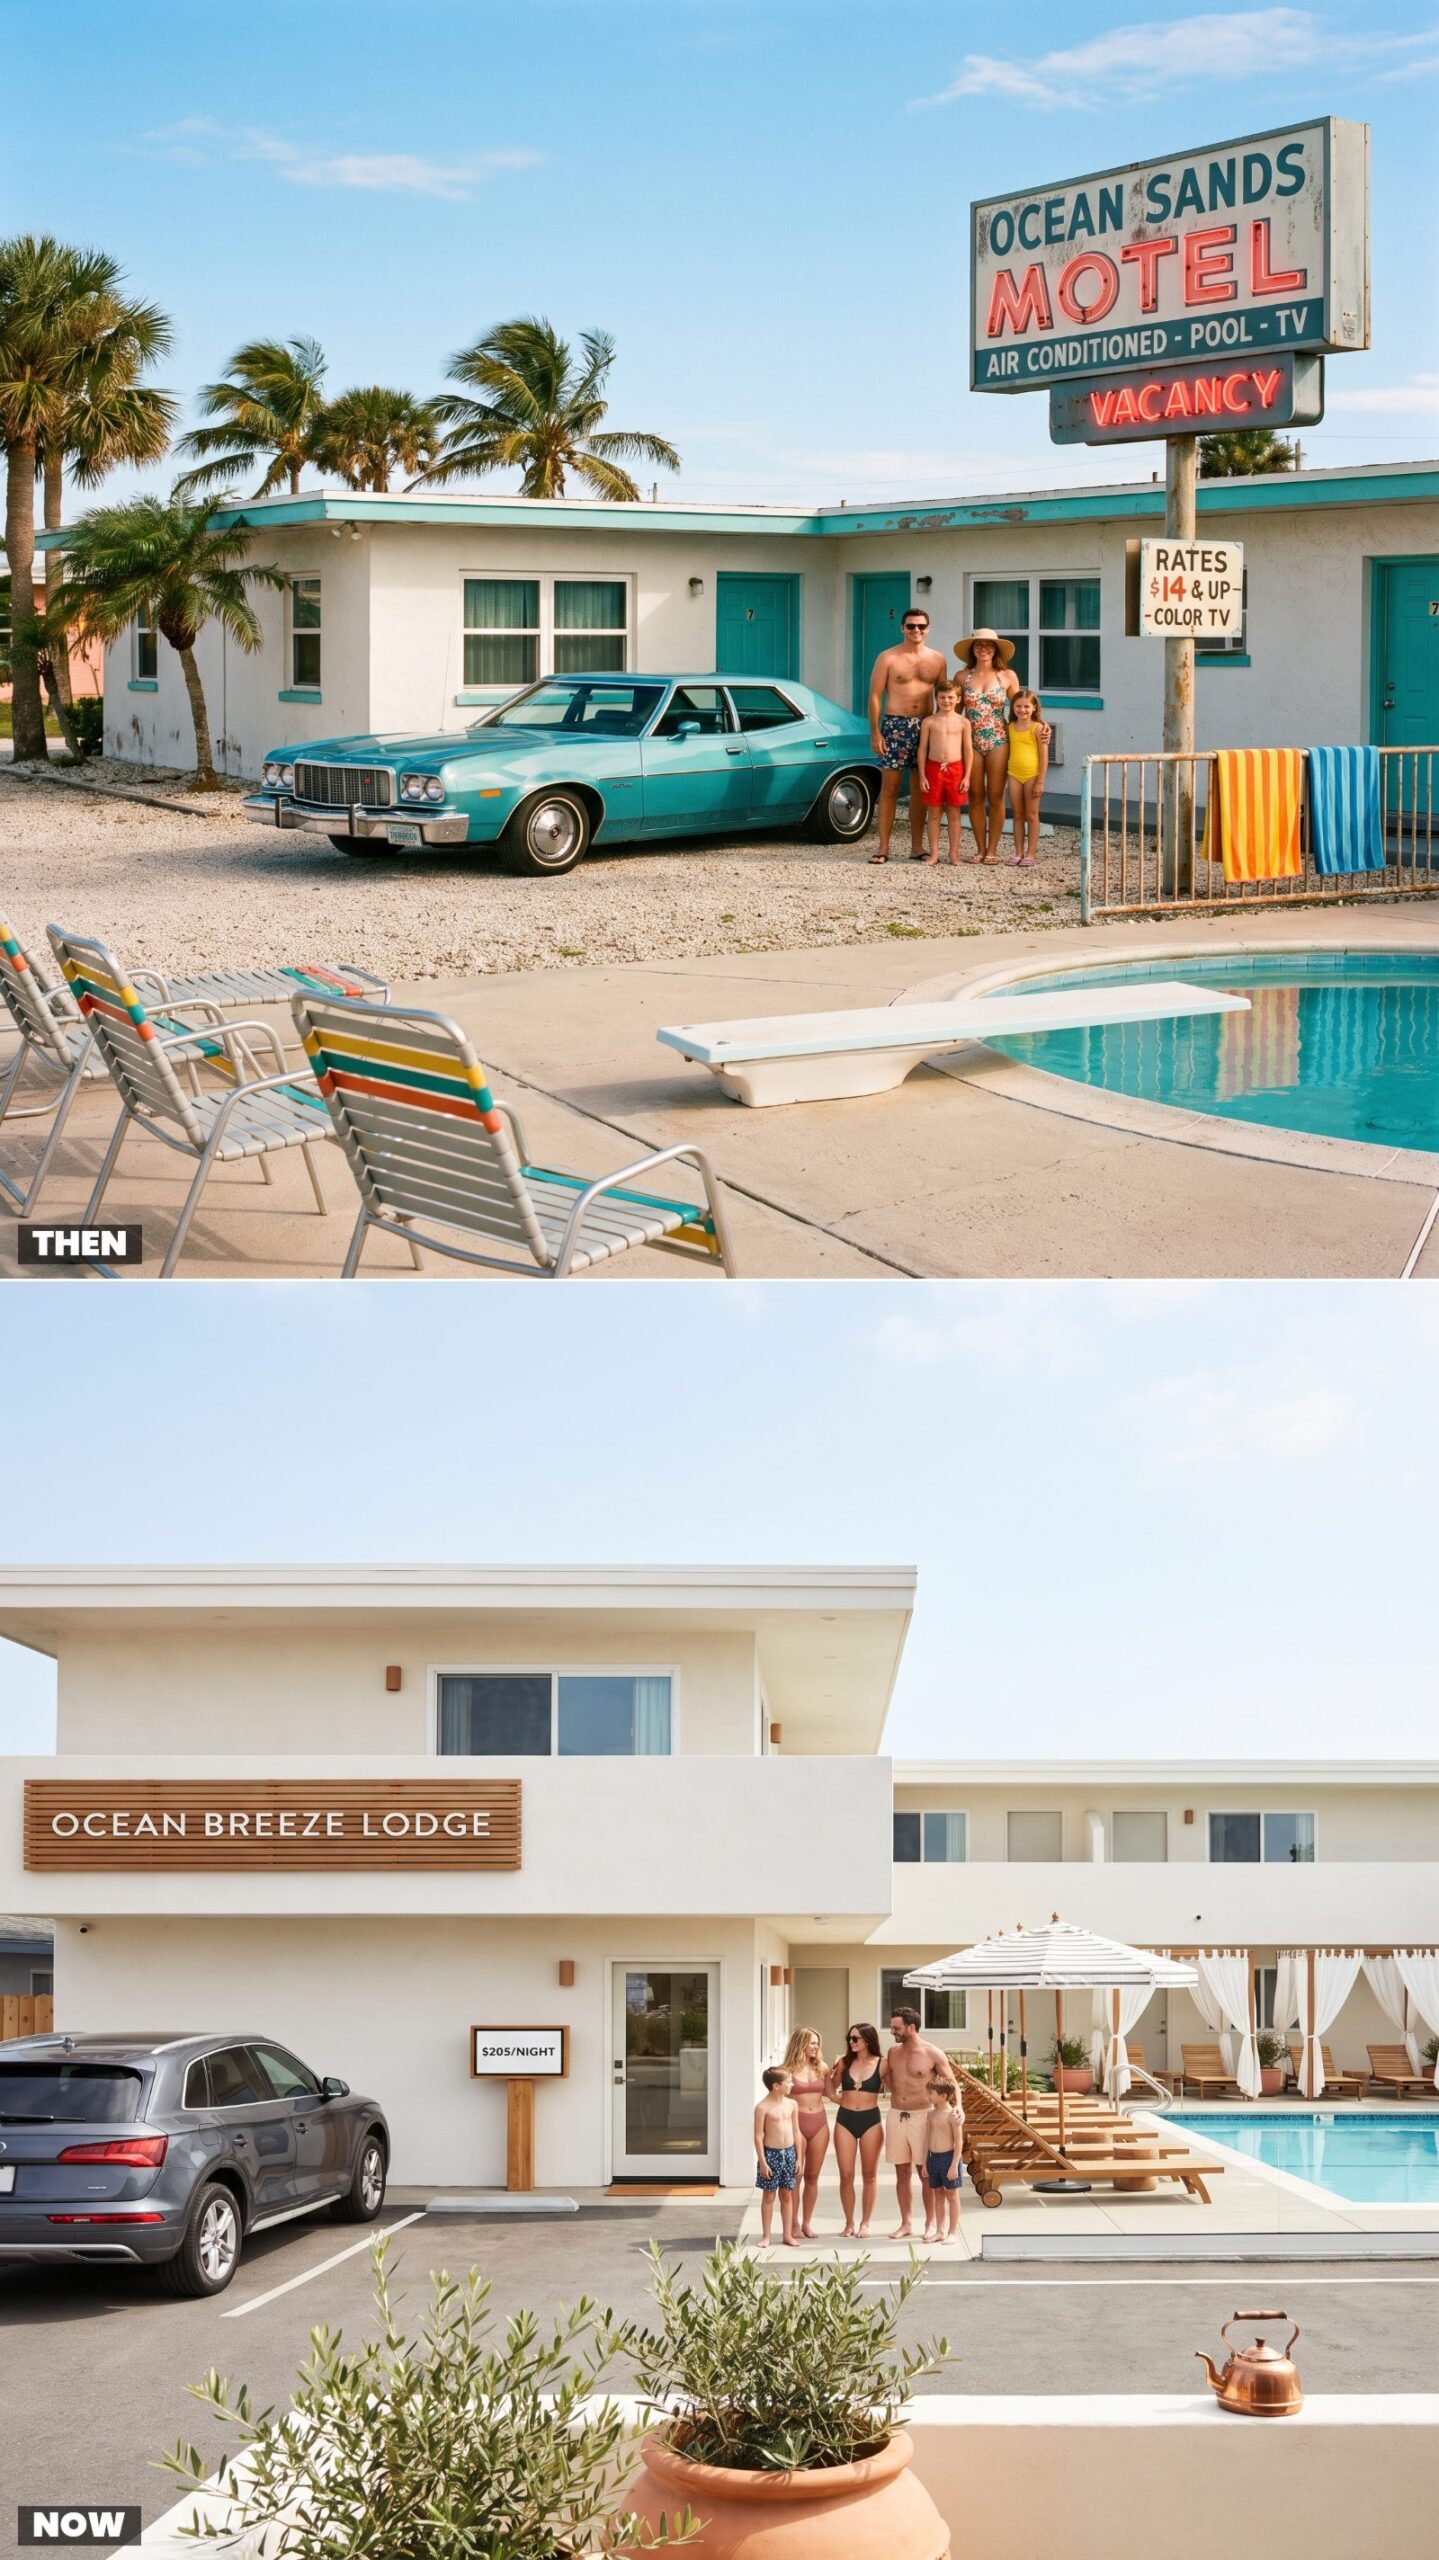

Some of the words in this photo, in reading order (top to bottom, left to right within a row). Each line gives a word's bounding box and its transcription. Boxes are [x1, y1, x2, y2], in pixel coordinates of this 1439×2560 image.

[989, 184, 1124, 257] OCEAN
[1145, 143, 1306, 224] SANDS
[986, 217, 1308, 339] MOTEL
[986, 350, 1019, 378] AIR
[1027, 330, 1168, 372] CONDITIONED
[1190, 316, 1253, 350] POOL
[1275, 307, 1309, 336] TV
[1089, 367, 1284, 428] VACANCY
[1156, 548, 1228, 573] RATES
[1150, 575, 1187, 603] $14
[1191, 579, 1204, 602] &
[1208, 608, 1231, 627] TV
[51, 1812, 187, 1838] OCEAN
[203, 1812, 345, 1838] BREEZE
[362, 1812, 492, 1838] LODGE
[482, 2046, 556, 2058] $205/NIGHT
